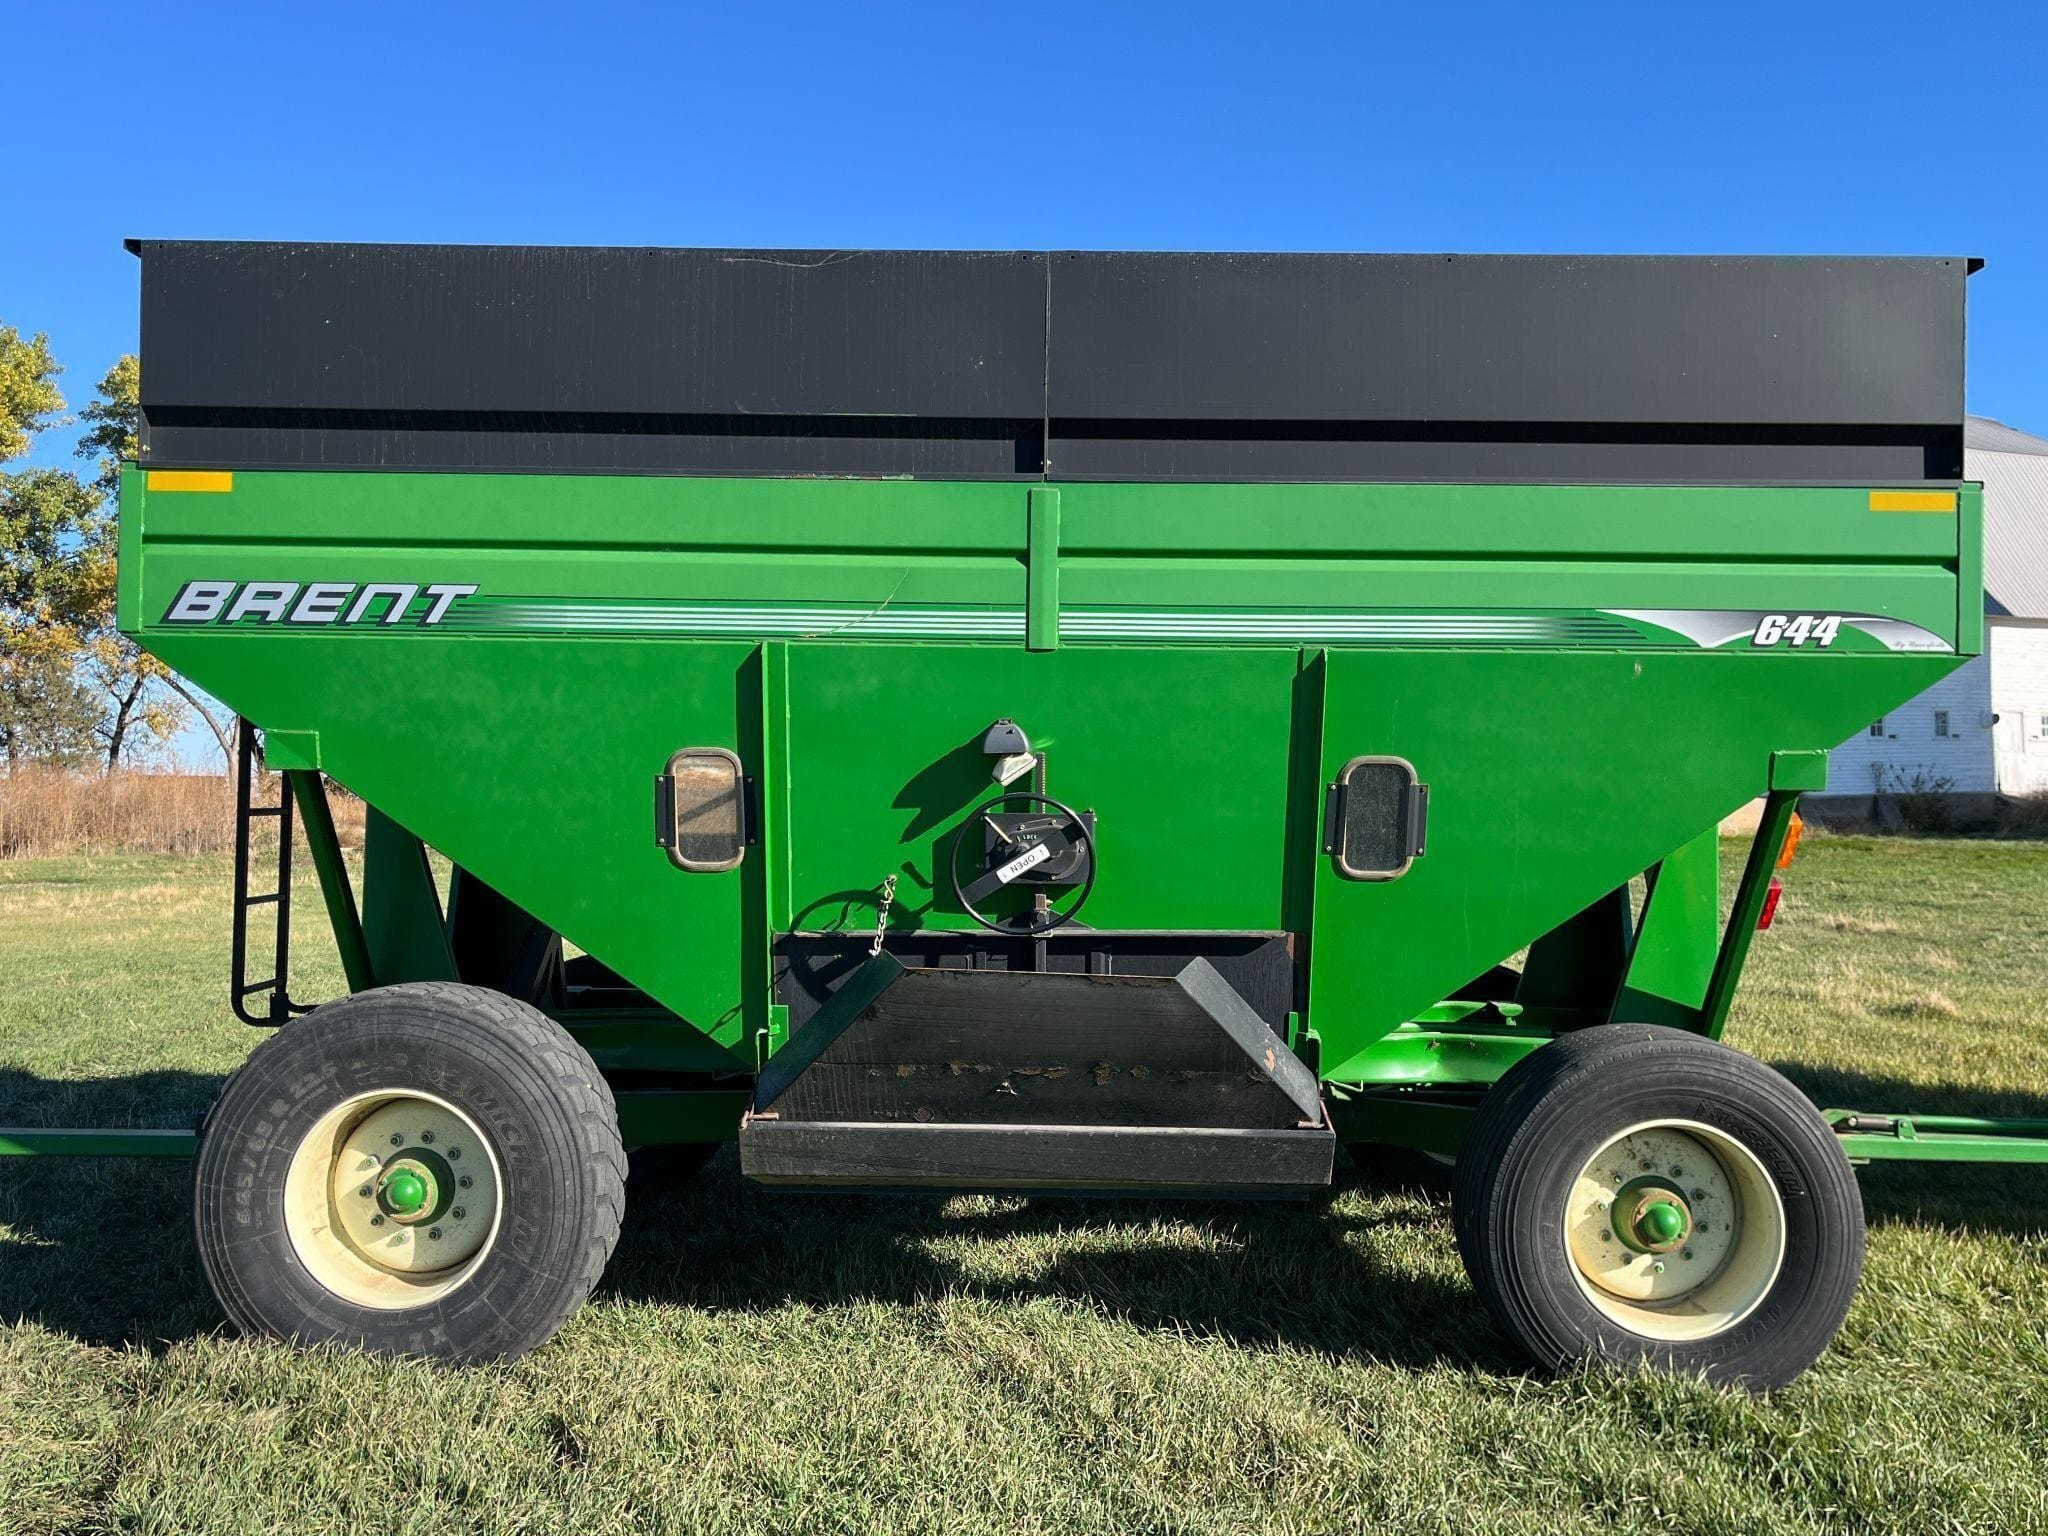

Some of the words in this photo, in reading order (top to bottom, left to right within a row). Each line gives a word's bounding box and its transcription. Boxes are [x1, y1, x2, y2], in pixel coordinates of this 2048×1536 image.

[159, 580, 481, 627] BRENT
[1751, 614, 1842, 648] 644
[1009, 855, 1035, 874] OPEN
[467, 1084, 541, 1264] MICHELIN
